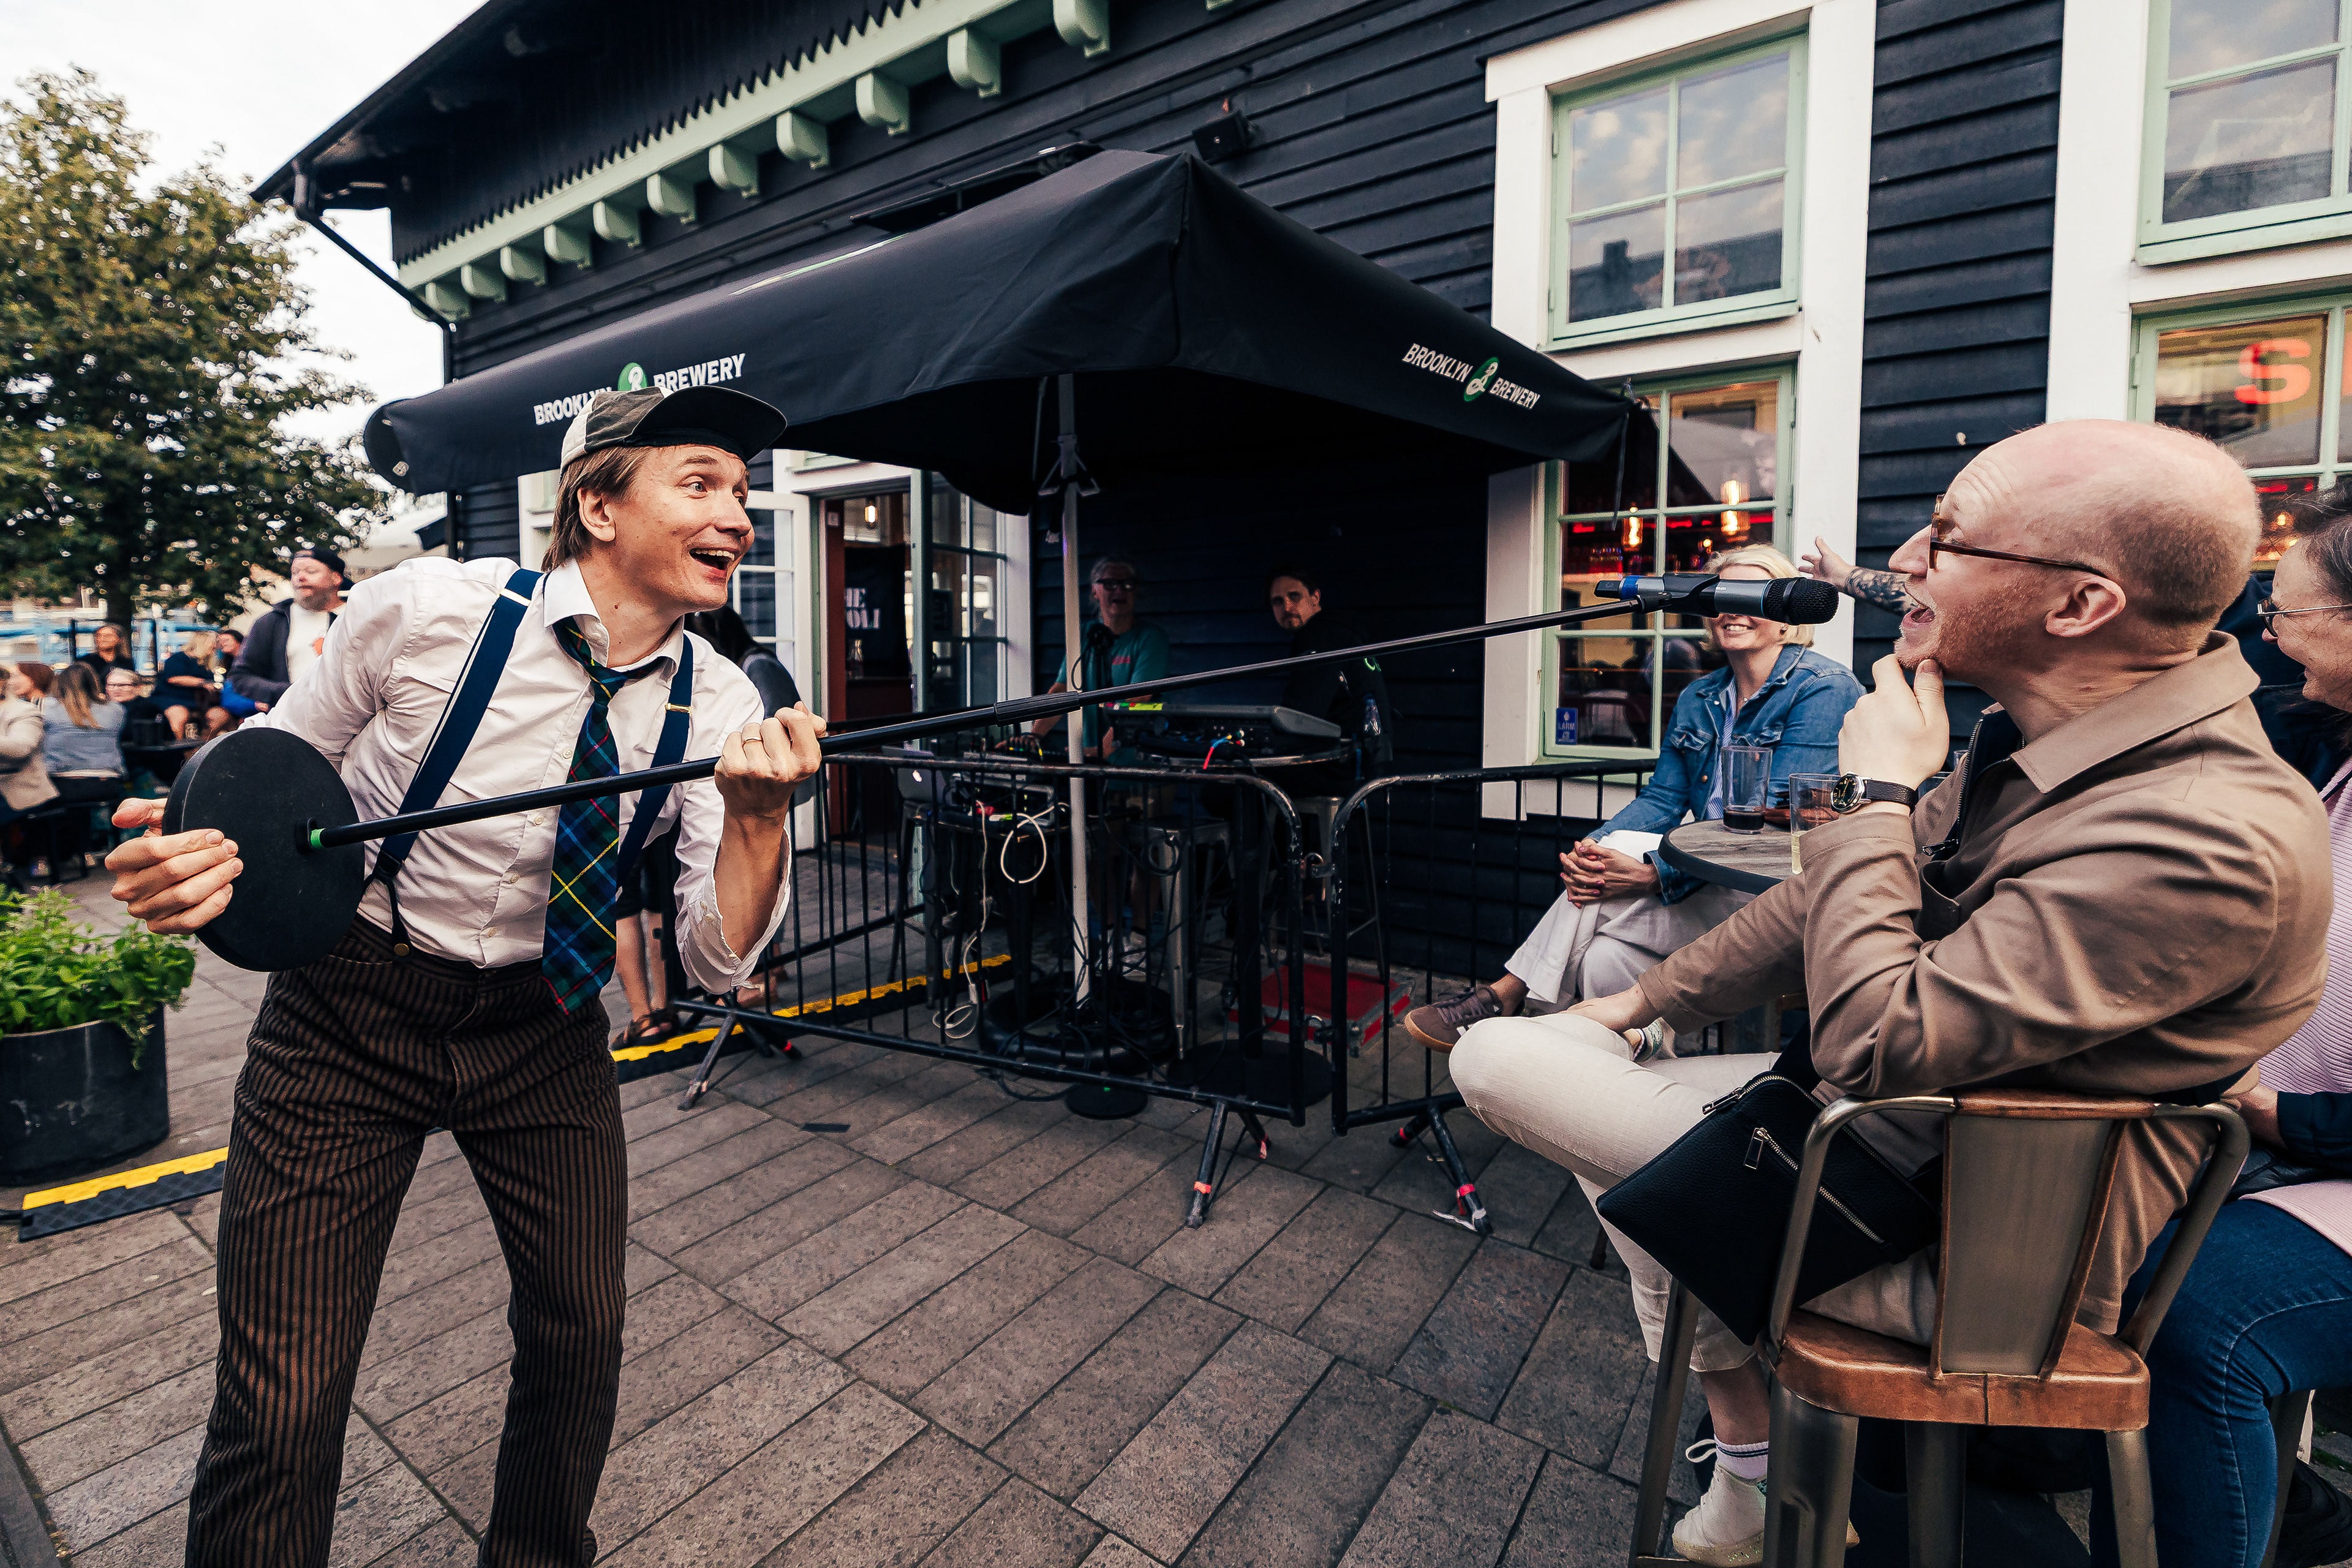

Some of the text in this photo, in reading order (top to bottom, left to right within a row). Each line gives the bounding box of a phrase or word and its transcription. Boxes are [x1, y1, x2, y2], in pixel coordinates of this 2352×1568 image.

[533, 386, 612, 426] BROOKL
[653, 353, 745, 391] BREWERY
[1402, 344, 1473, 382] BROOKLYN
[1490, 378, 1540, 409] BREWERY
